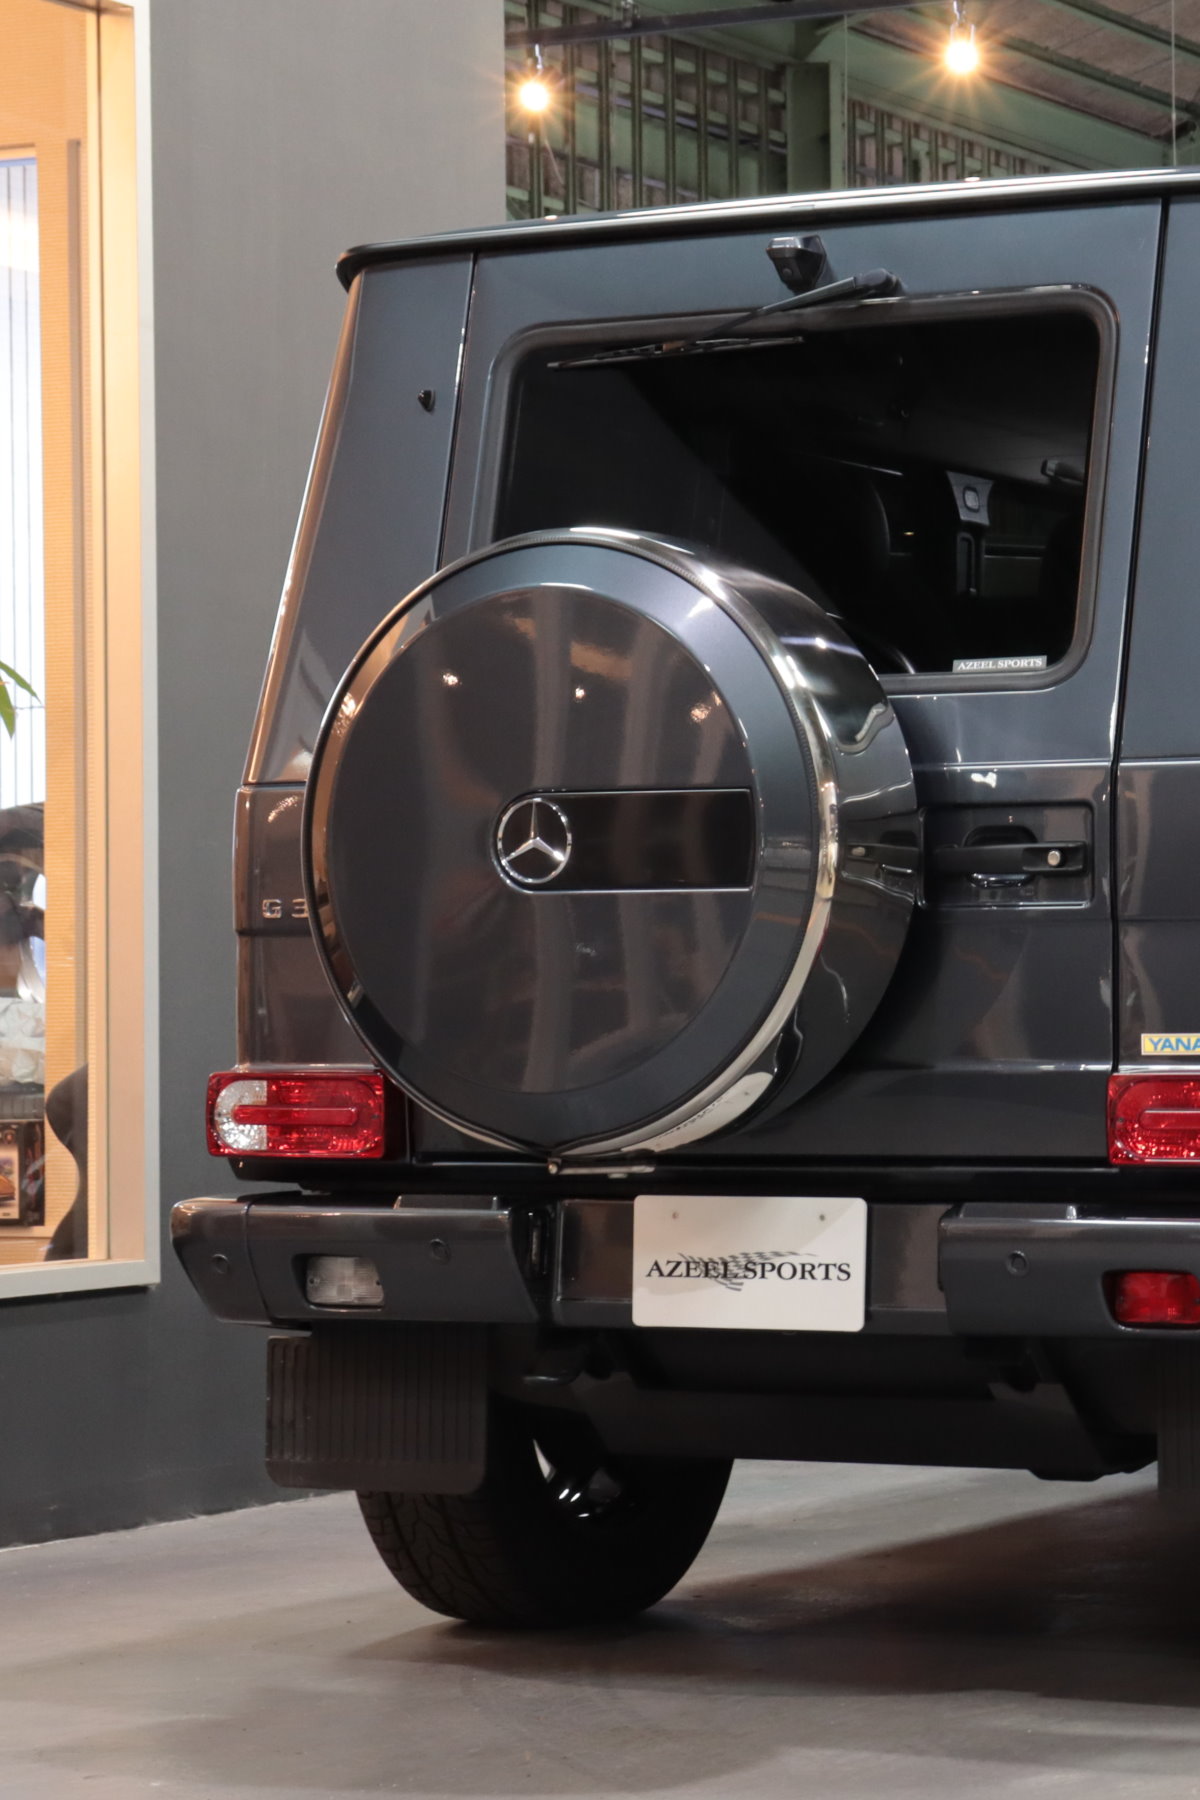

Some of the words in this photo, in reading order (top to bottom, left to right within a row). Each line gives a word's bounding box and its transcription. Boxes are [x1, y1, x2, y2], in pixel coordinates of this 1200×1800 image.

[957, 661, 996, 671] AZEEL
[997, 658, 1043, 669] SPORTS
[262, 899, 282, 918] G
[646, 1259, 740, 1280] AZEEL
[742, 1261, 852, 1281] SPORTS
